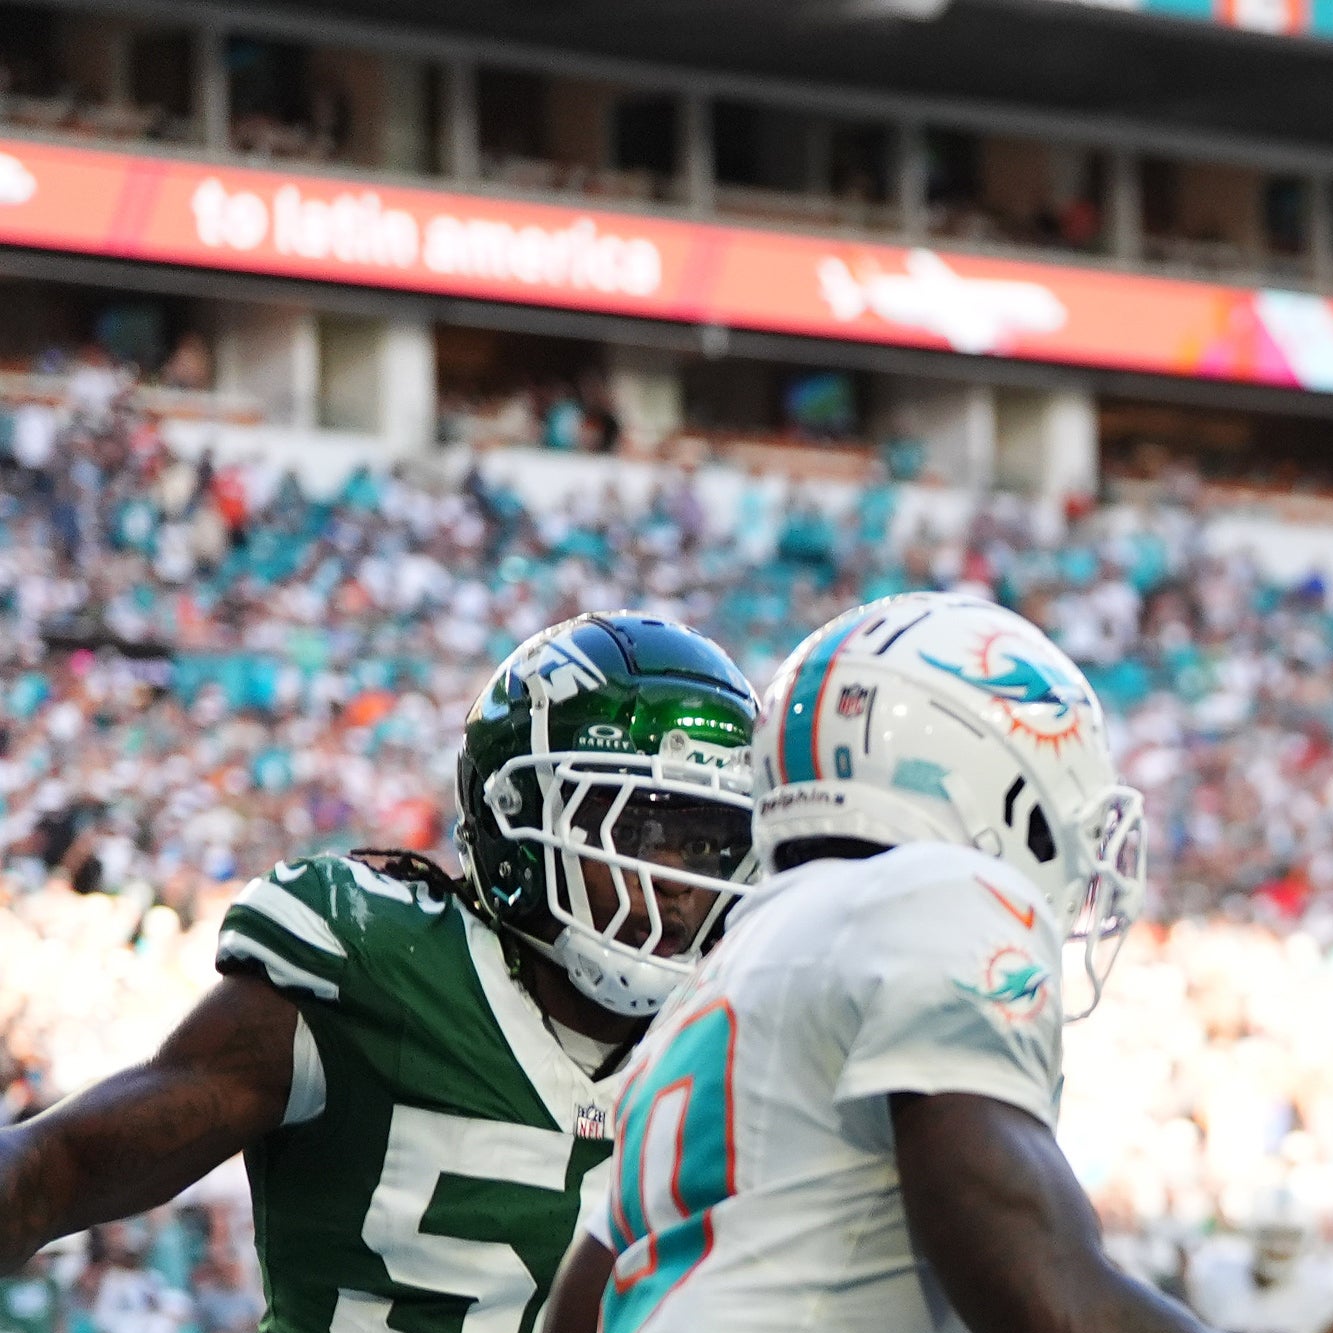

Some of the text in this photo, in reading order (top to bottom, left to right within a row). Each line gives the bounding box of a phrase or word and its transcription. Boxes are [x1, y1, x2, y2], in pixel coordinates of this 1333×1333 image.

[192, 177, 661, 297] to latin america
